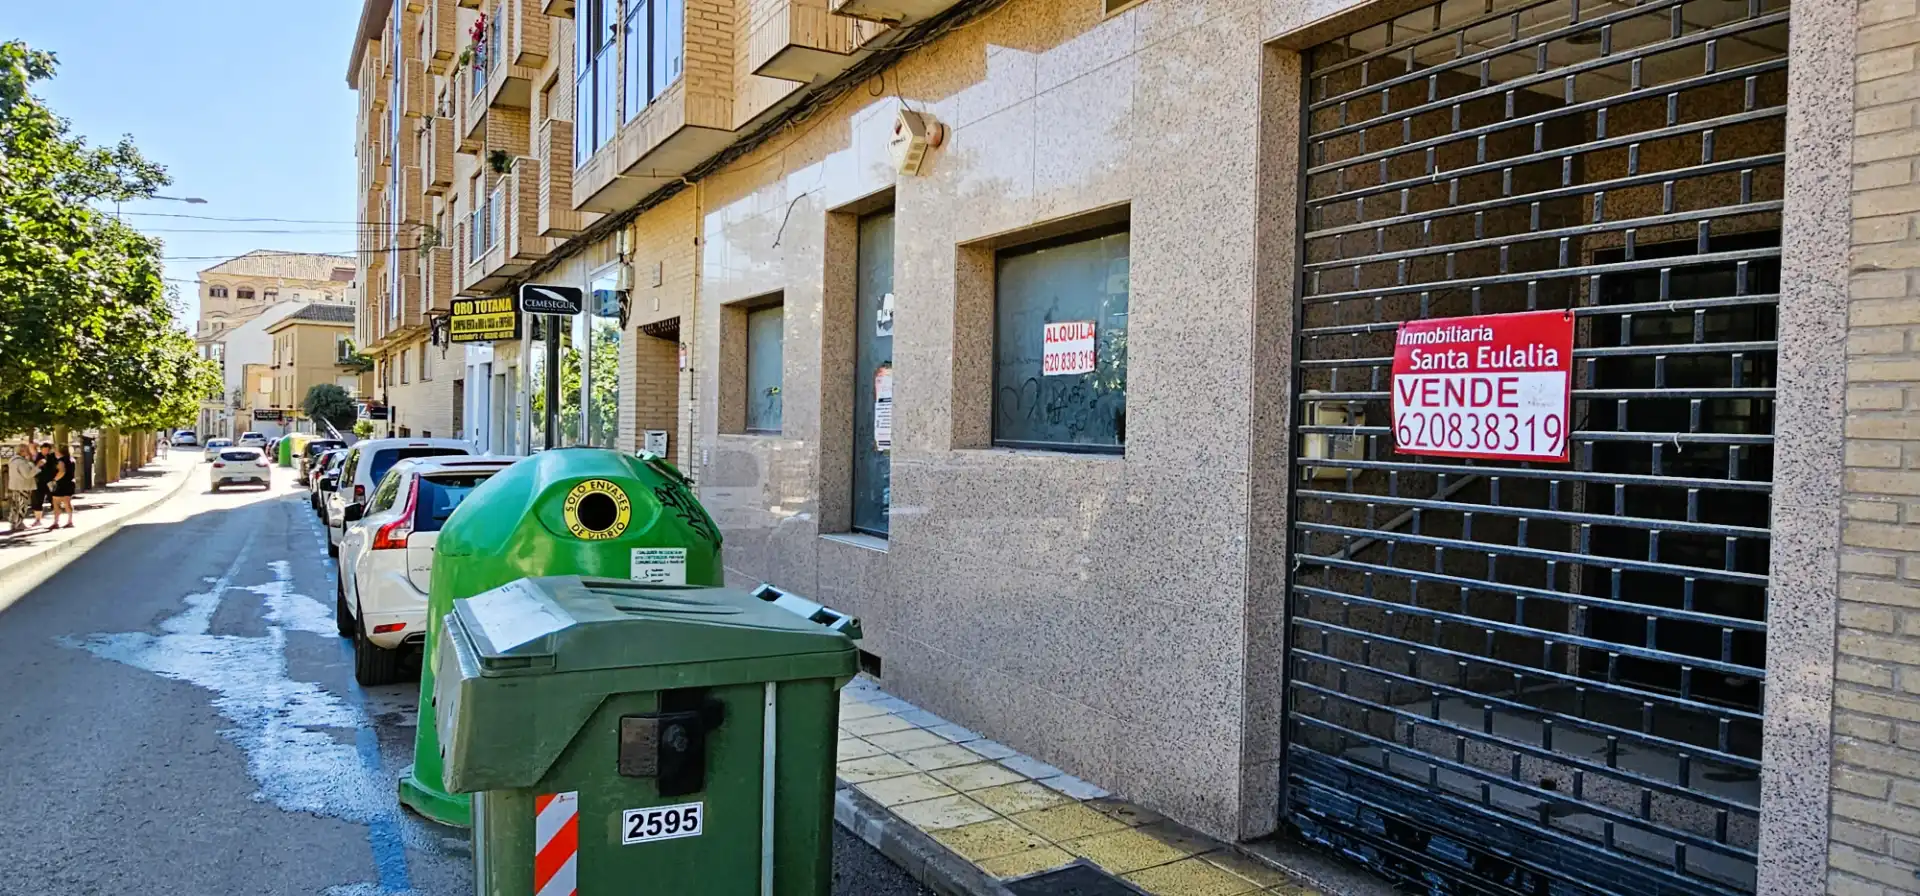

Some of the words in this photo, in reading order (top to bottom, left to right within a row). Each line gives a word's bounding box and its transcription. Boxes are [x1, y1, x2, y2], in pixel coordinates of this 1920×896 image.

[454, 301, 473, 315] ORO
[474, 298, 512, 313] TOTANA
[525, 299, 578, 312] CEMESEGUR
[1046, 321, 1095, 343] ALQUILA
[1399, 324, 1494, 345] Inmobiliaria
[1045, 353, 1060, 371] 620
[1061, 351, 1077, 370] 838
[1078, 350, 1095, 369] 319
[1410, 348, 1469, 370] Santa
[1476, 343, 1559, 369] Eulalia
[1398, 377, 1519, 408] VENDE
[1398, 412, 1562, 452] 620838319
[565, 484, 587, 512] SOLO
[590, 480, 629, 512] ENVASES
[571, 522, 583, 537] DE
[588, 521, 626, 540] VIDRIO
[628, 807, 699, 838] 2595
